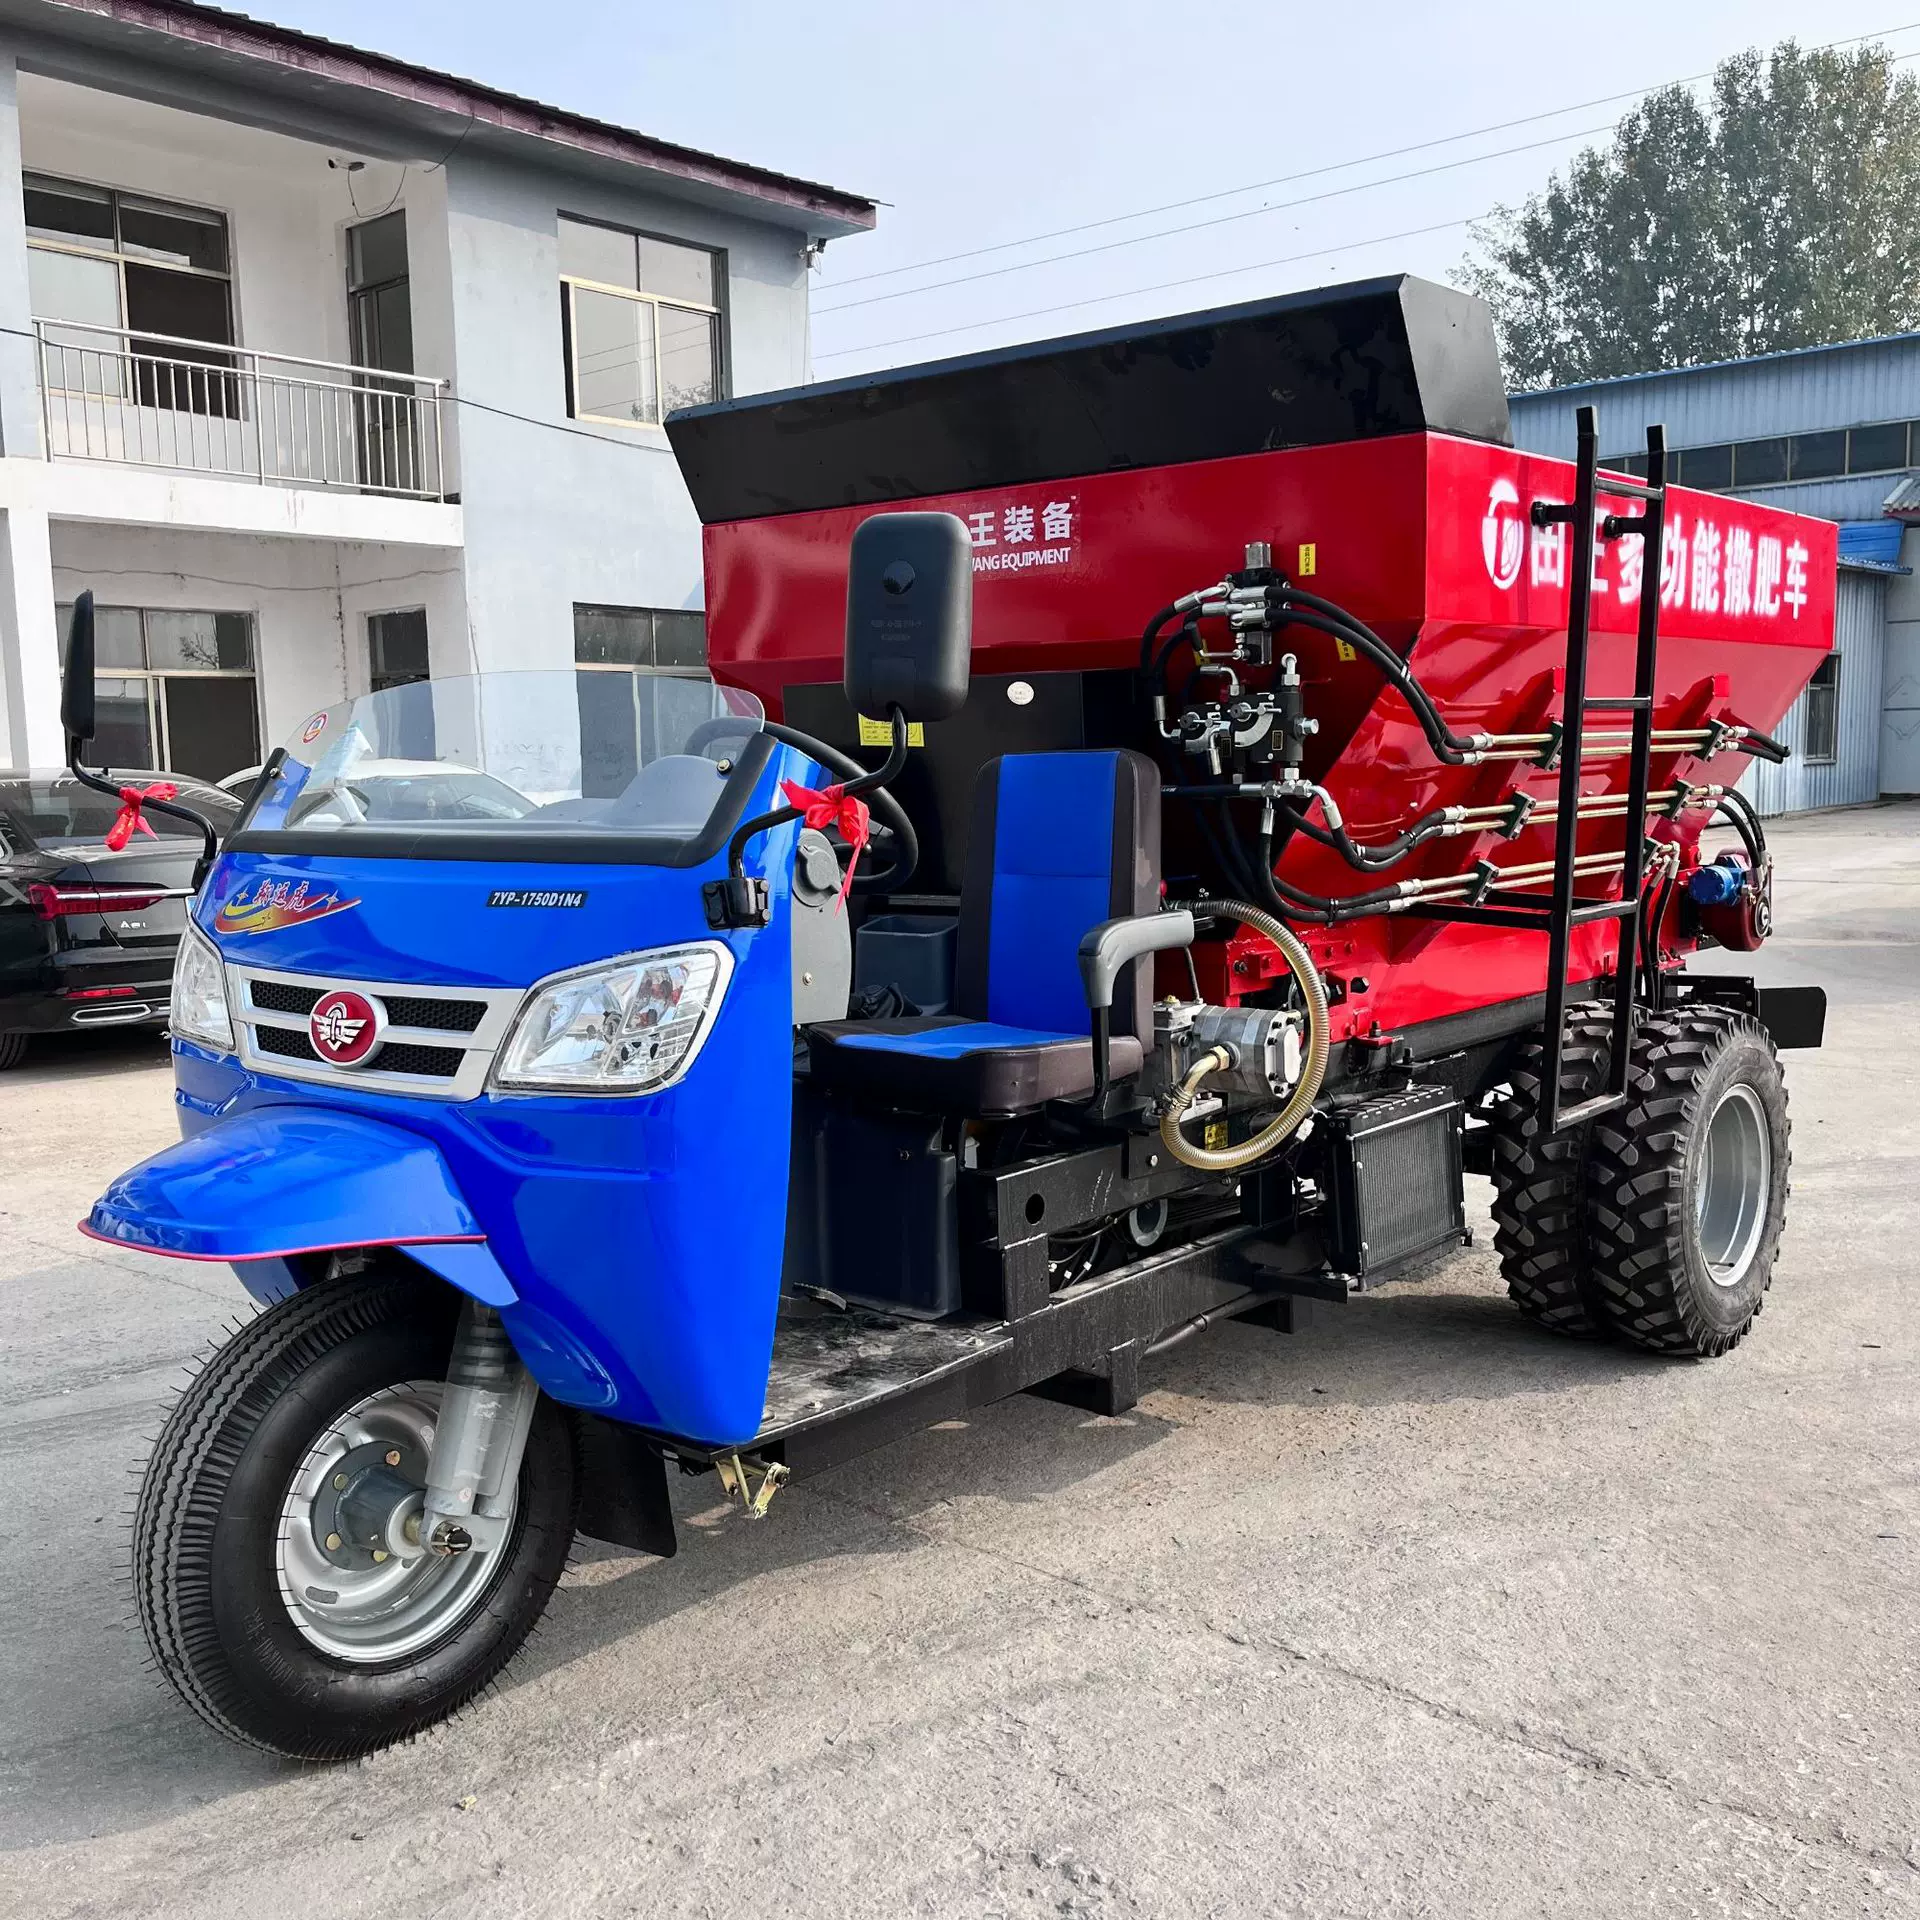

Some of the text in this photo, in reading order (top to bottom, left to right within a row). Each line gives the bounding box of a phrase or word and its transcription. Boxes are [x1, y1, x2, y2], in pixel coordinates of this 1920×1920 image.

[968, 501, 1073, 547] 王装备
[972, 547, 1071, 572] ANG EQUIPMENT
[491, 891, 582, 907] 7YP-1750D1N4
